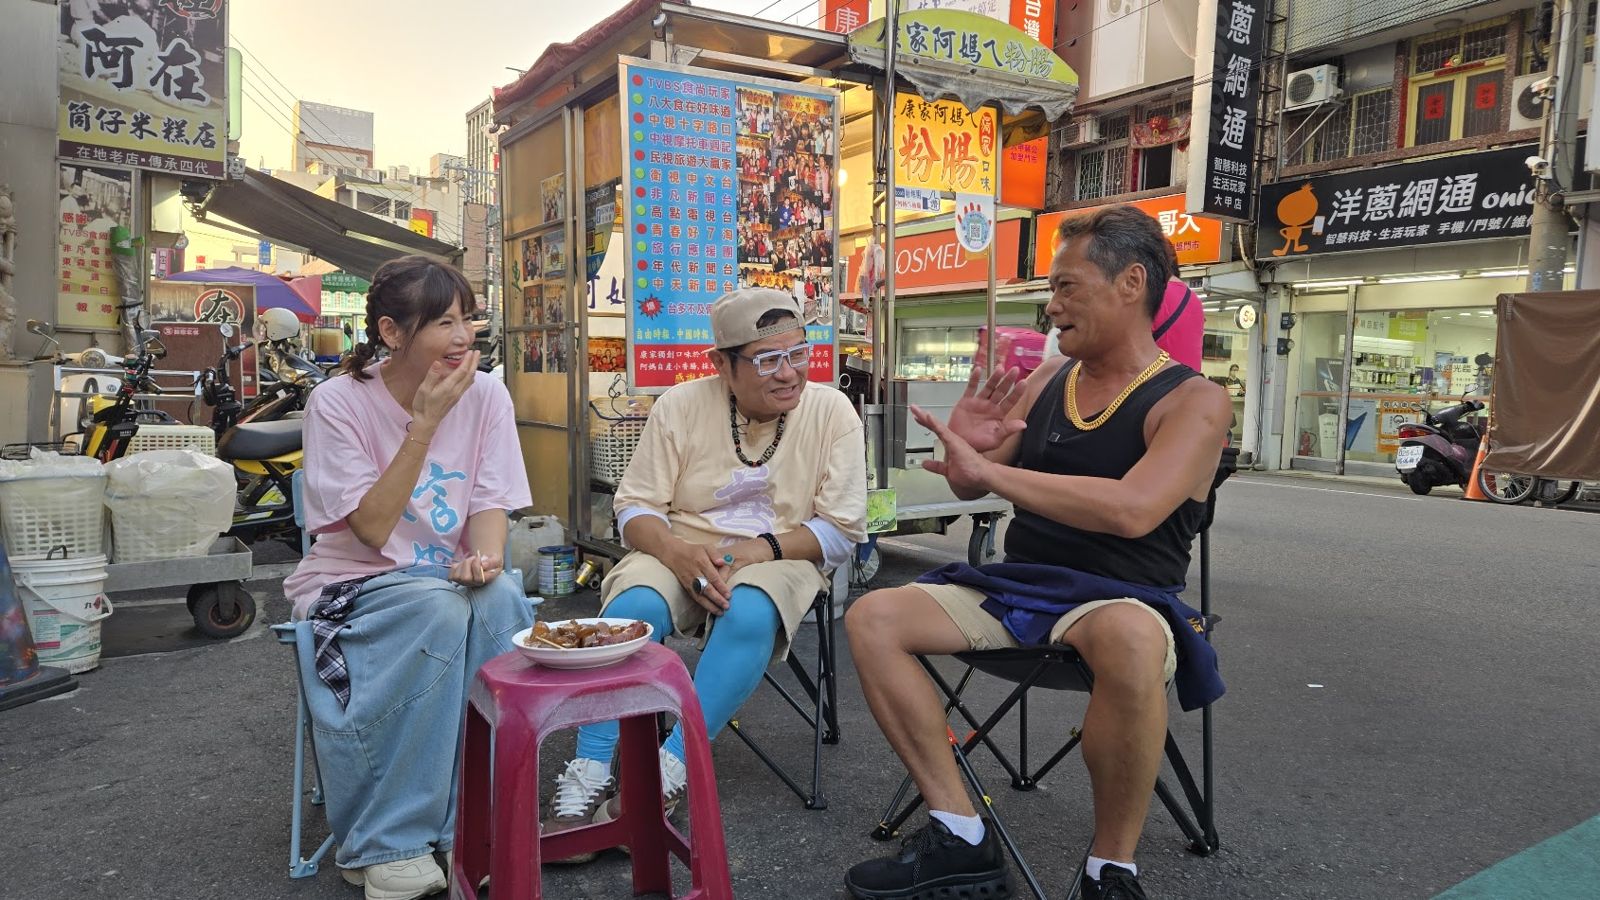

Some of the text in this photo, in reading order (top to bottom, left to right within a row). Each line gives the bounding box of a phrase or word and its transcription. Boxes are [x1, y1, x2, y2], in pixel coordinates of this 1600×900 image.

[80, 27, 207, 102] 阿在
[647, 77, 730, 100] TVBS食尚玩家
[649, 96, 731, 118] 八大食在好味道
[68, 102, 216, 149] 筒仔米糕店
[649, 114, 731, 136] 中視十字路口
[649, 132, 732, 154] 中視摩托車週記
[1214, 157, 1248, 177] 智慧科技
[1212, 175, 1247, 194] 生活玩家
[650, 187, 733, 206] 非凡新聞台
[1214, 194, 1243, 210] 大甲店
[651, 205, 733, 223] 高點電視台
[652, 259, 734, 275] 年代新聞台
[652, 277, 734, 293] 中天新聞台
